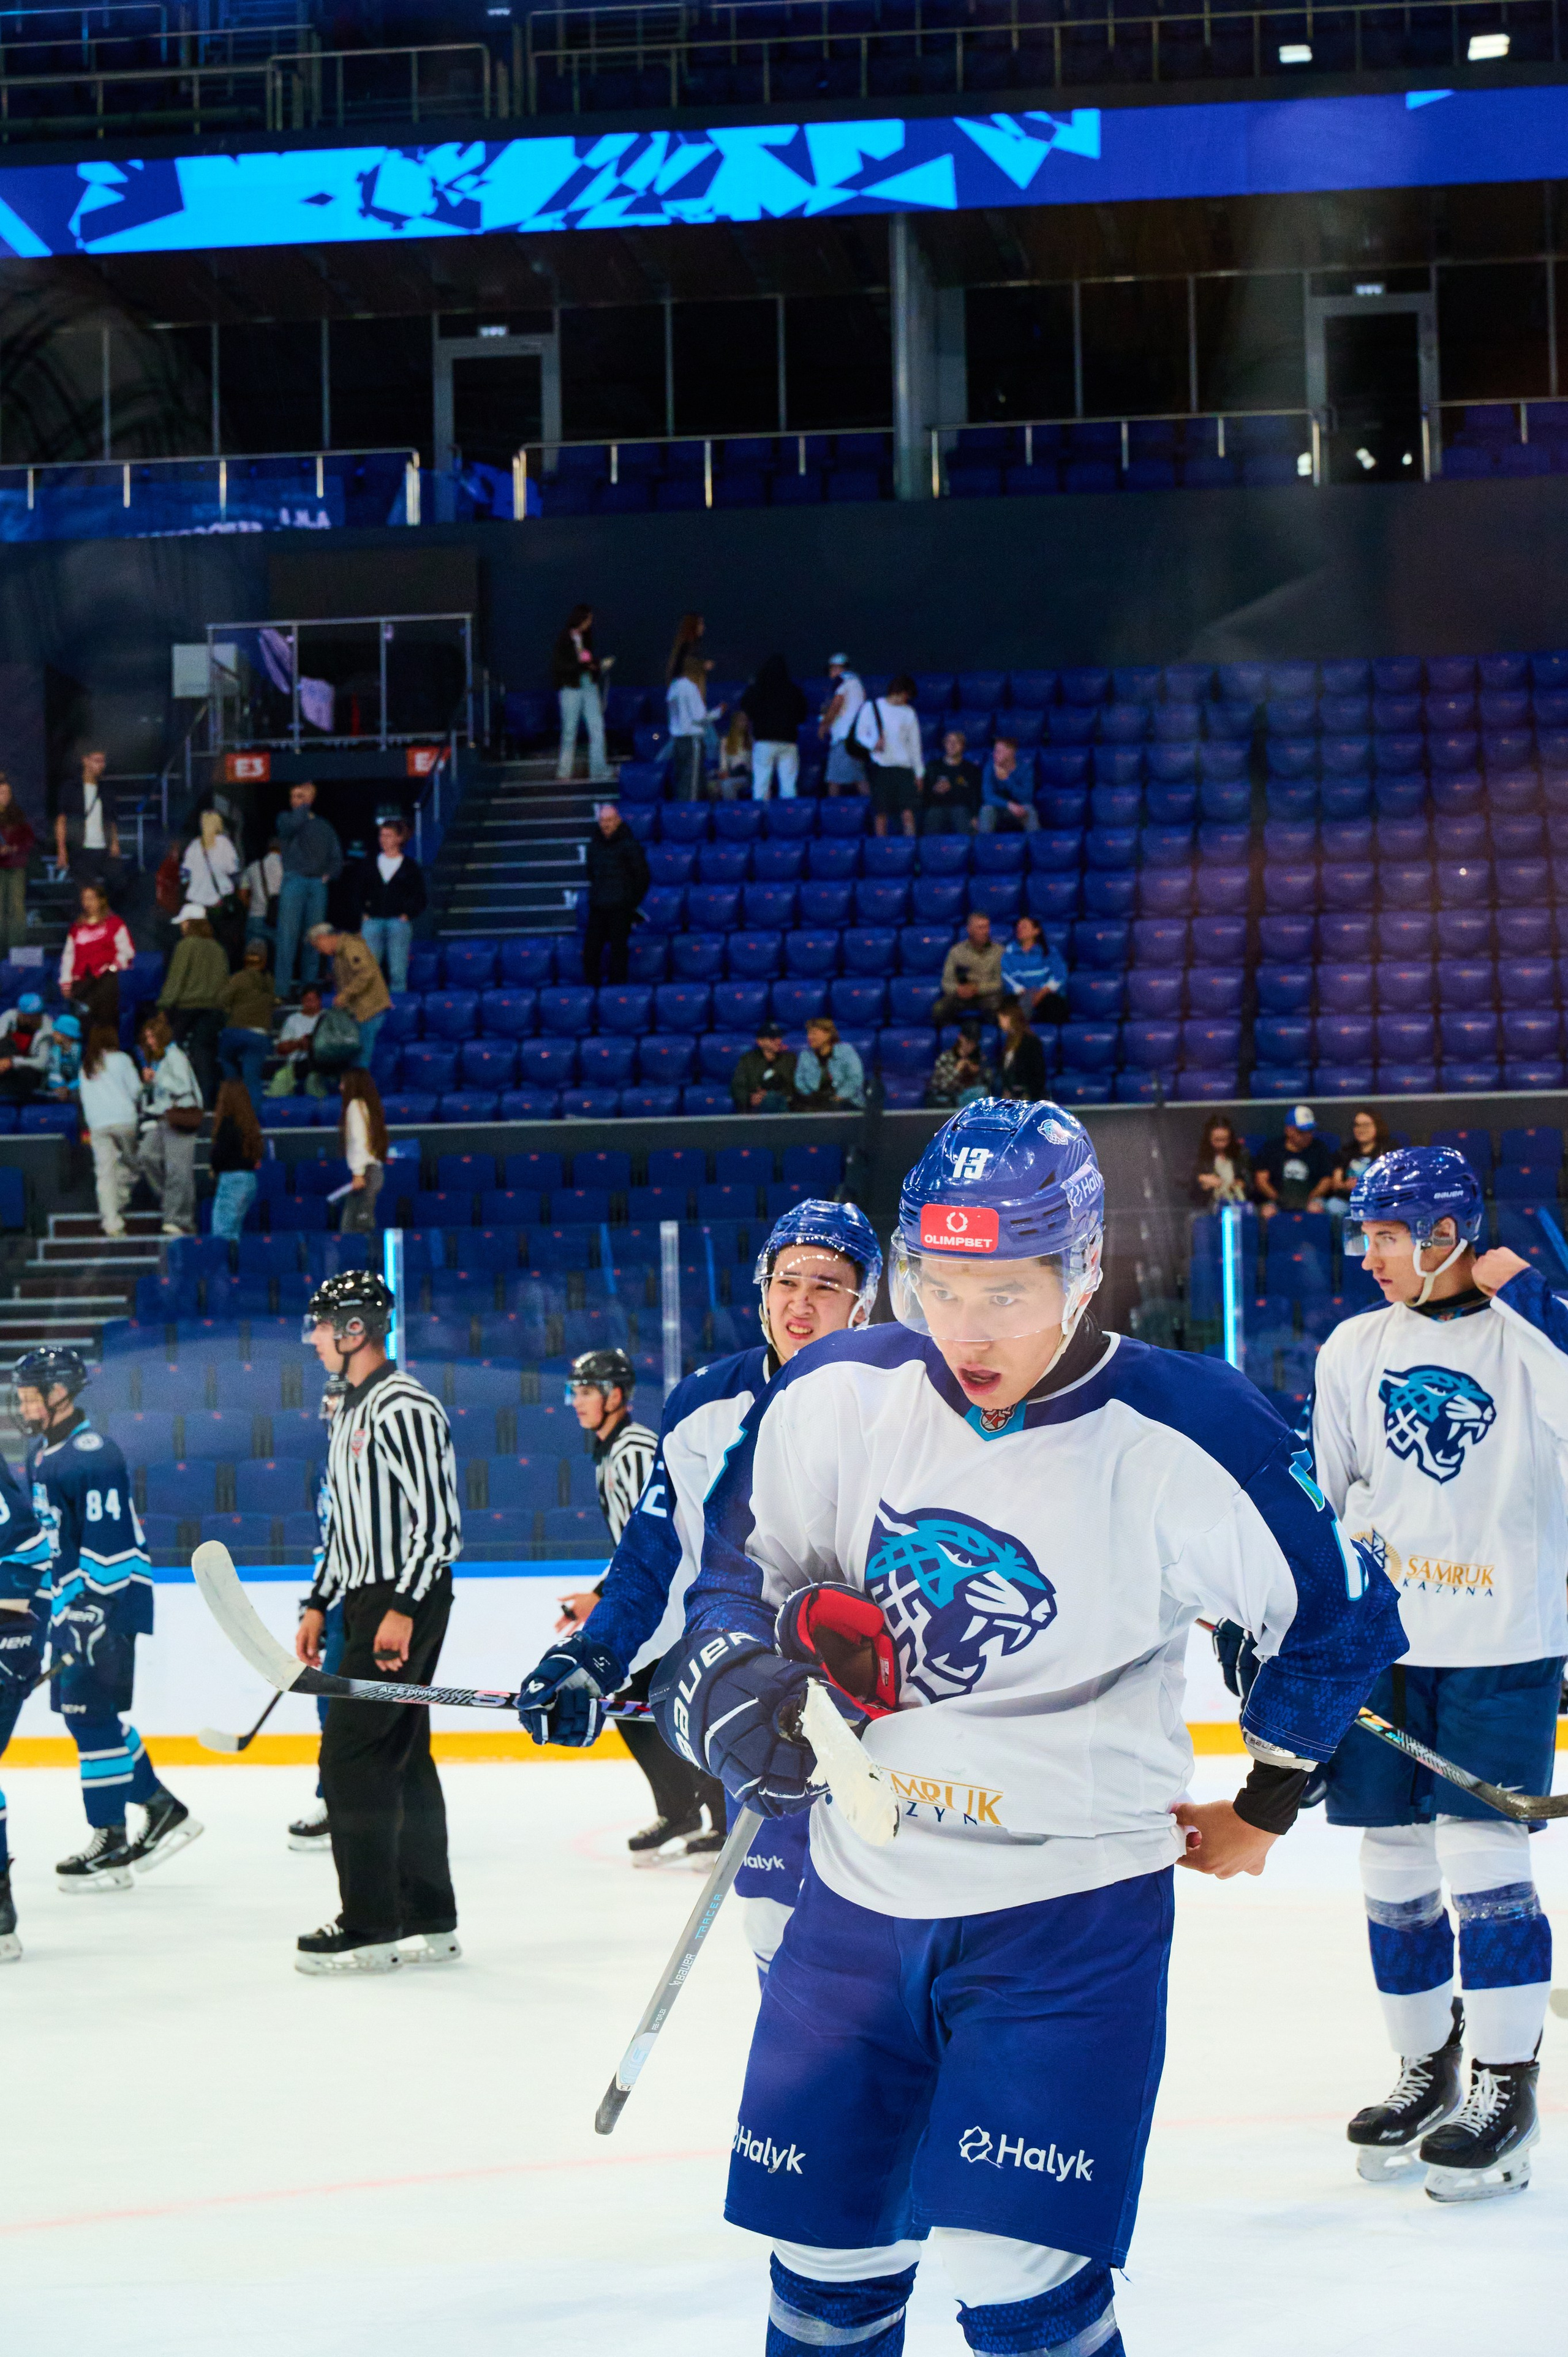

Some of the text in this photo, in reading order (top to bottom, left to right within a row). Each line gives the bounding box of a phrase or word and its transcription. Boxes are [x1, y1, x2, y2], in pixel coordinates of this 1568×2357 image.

[952, 1147, 989, 1179] 13
[1081, 1169, 1102, 1199] Haly
[924, 1234, 993, 1248] OLIMPBET
[86, 1488, 121, 1522] 84
[1406, 1557, 1494, 1585] SAMRUK
[1403, 1578, 1493, 1597] KAZYNA
[378, 1685, 405, 1695] ACE
[407, 1689, 439, 1700] prime
[891, 1773, 1003, 1825] MRUK
[906, 1801, 977, 1825] ZYN
[695, 1894, 723, 1939] TRACER
[676, 1953, 695, 1981] BAUER
[736, 2129, 806, 2174] Halyk
[996, 2134, 1095, 2182] Halyk
